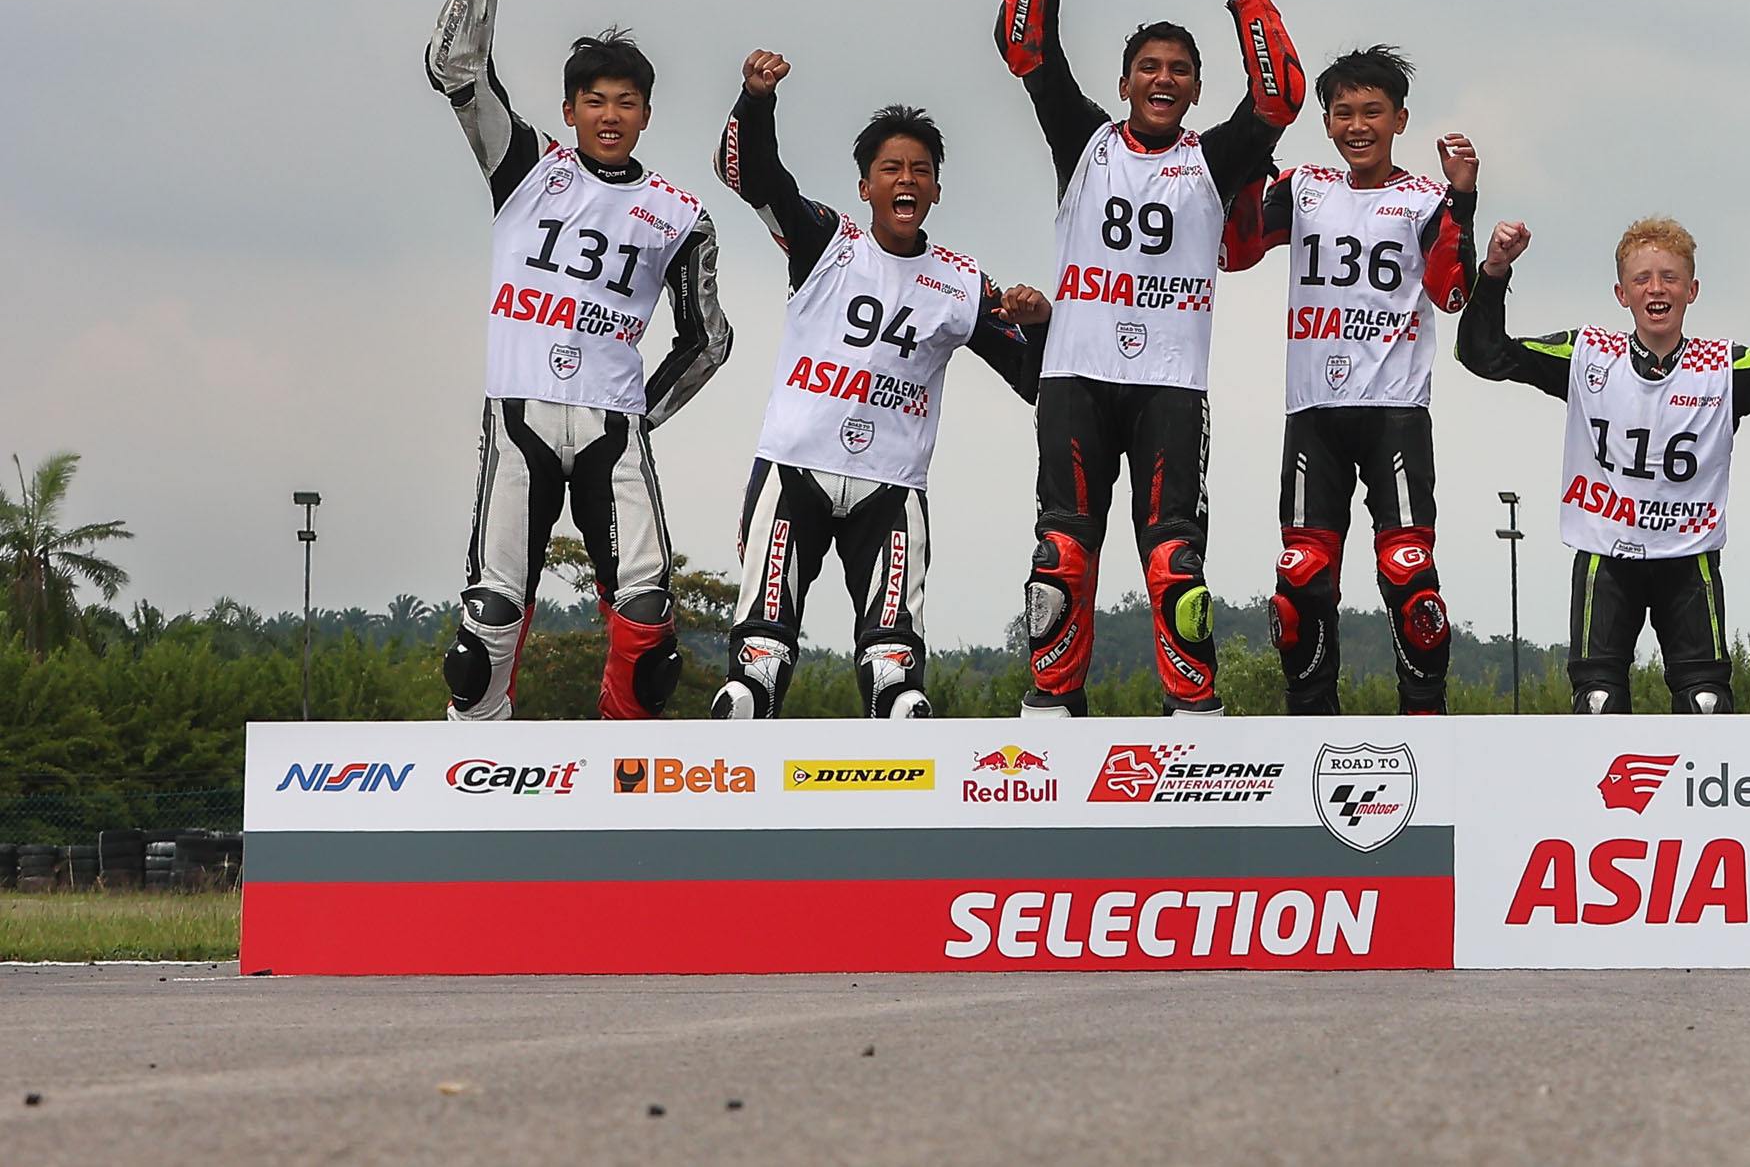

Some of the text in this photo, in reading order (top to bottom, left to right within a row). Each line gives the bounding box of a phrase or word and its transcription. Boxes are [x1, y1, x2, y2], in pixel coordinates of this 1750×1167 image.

[1250, 19, 1279, 96] TAICHI
[726, 119, 741, 192] HONDA
[629, 206, 656, 226] ASIA
[1101, 195, 1175, 256] 89
[1376, 207, 1403, 217] ASIA
[525, 219, 642, 299] 131
[1300, 234, 1404, 292] 136
[916, 274, 942, 291] ASIA
[1056, 264, 1206, 307] ASIA TALENT
[1136, 292, 1175, 310] CUP
[491, 283, 577, 331] ASIA
[578, 300, 640, 329] TALENT
[1344, 309, 1412, 329] TALENT
[576, 318, 616, 337] CUP
[842, 295, 918, 359] 94
[1342, 325, 1381, 342] CUP
[786, 356, 925, 405] ASIA TALENT
[869, 391, 904, 411] CUP
[1669, 395, 1698, 407] ASIA
[1589, 417, 1699, 483] 116
[1562, 474, 1709, 528] ASIA TALENT
[1637, 516, 1678, 533] CUP
[766, 521, 788, 621] SHARP
[881, 532, 906, 628] SHARP
[1035, 624, 1078, 673] TAICHI
[1158, 633, 1206, 686] TAICHI
[654, 758, 756, 793] Beta
[814, 768, 926, 783] DUNLOP
[1165, 762, 1286, 779] SEPANG
[1330, 757, 1400, 771] ROAD TO
[963, 779, 1058, 803] Red Bull
[1154, 790, 1273, 804] CIRCUIT
[1160, 779, 1276, 791] INTERNATIONAL
[1504, 838, 1749, 925] ASIA
[944, 889, 1380, 960] SELECTION
